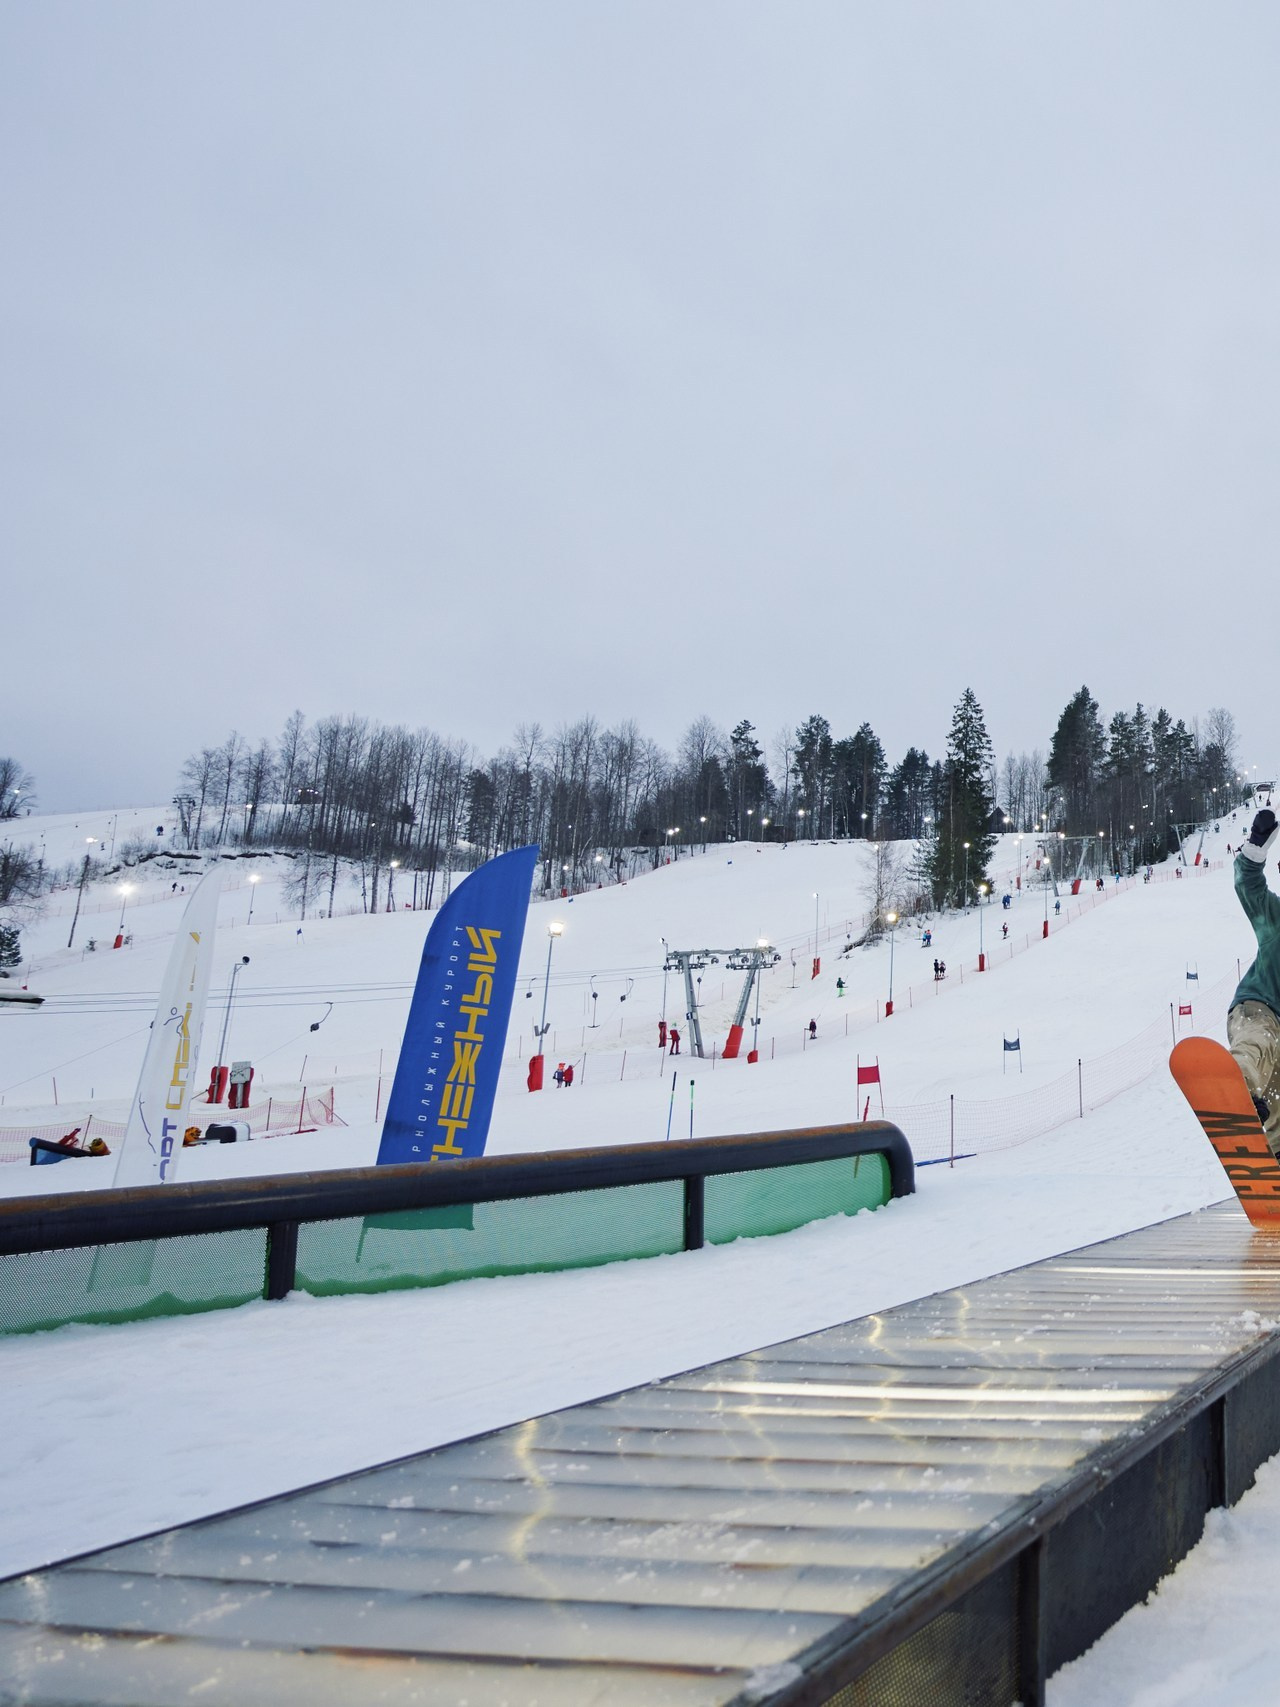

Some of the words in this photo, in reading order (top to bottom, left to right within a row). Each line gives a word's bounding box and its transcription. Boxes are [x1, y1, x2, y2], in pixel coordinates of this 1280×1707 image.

[410, 1021, 446, 1163] РНОЛЫЖНЫЙ
[441, 926, 464, 1006] КУРОРТ
[430, 926, 502, 1161] НЕЖНЫЙ
